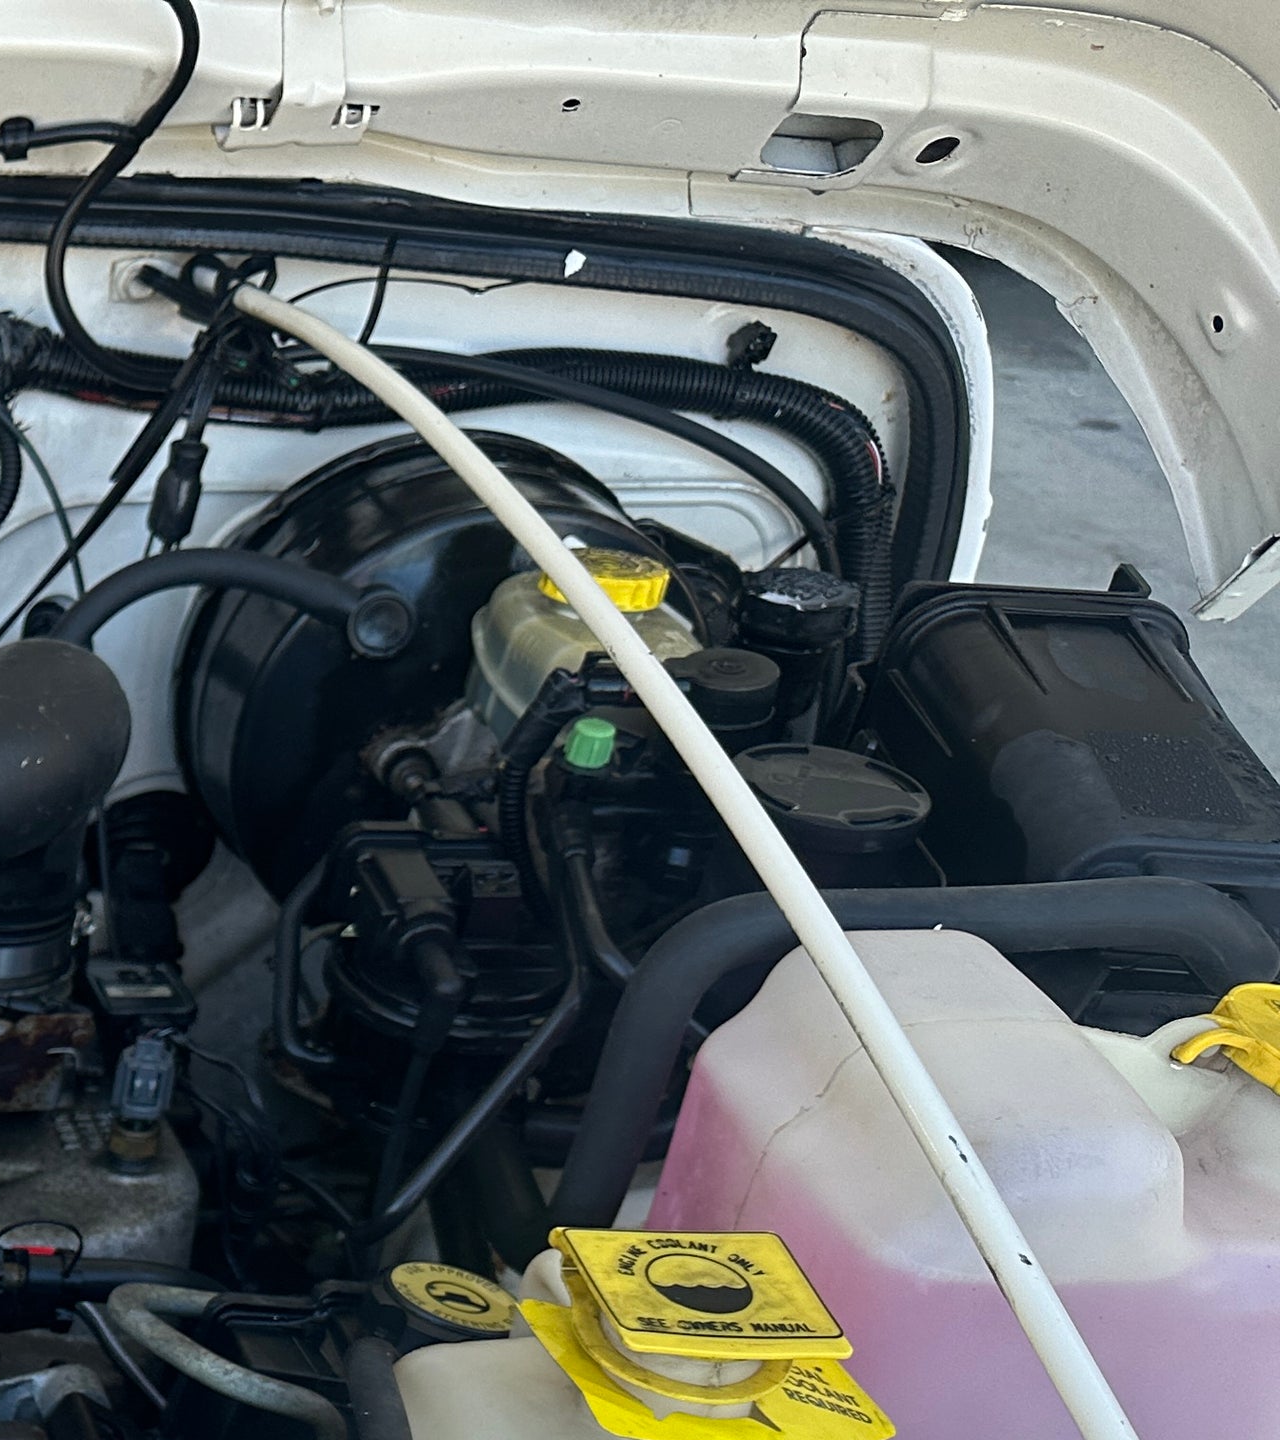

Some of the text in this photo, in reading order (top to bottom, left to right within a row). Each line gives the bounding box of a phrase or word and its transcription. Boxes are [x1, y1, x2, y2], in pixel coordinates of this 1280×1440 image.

[617, 1239, 767, 1277] ENGINE COOLANT ONLY
[430, 1266, 502, 1293] APPROVED
[637, 1317, 817, 1333] SEE OWNERS MANUAL
[782, 1386, 873, 1424] REQUIRED
